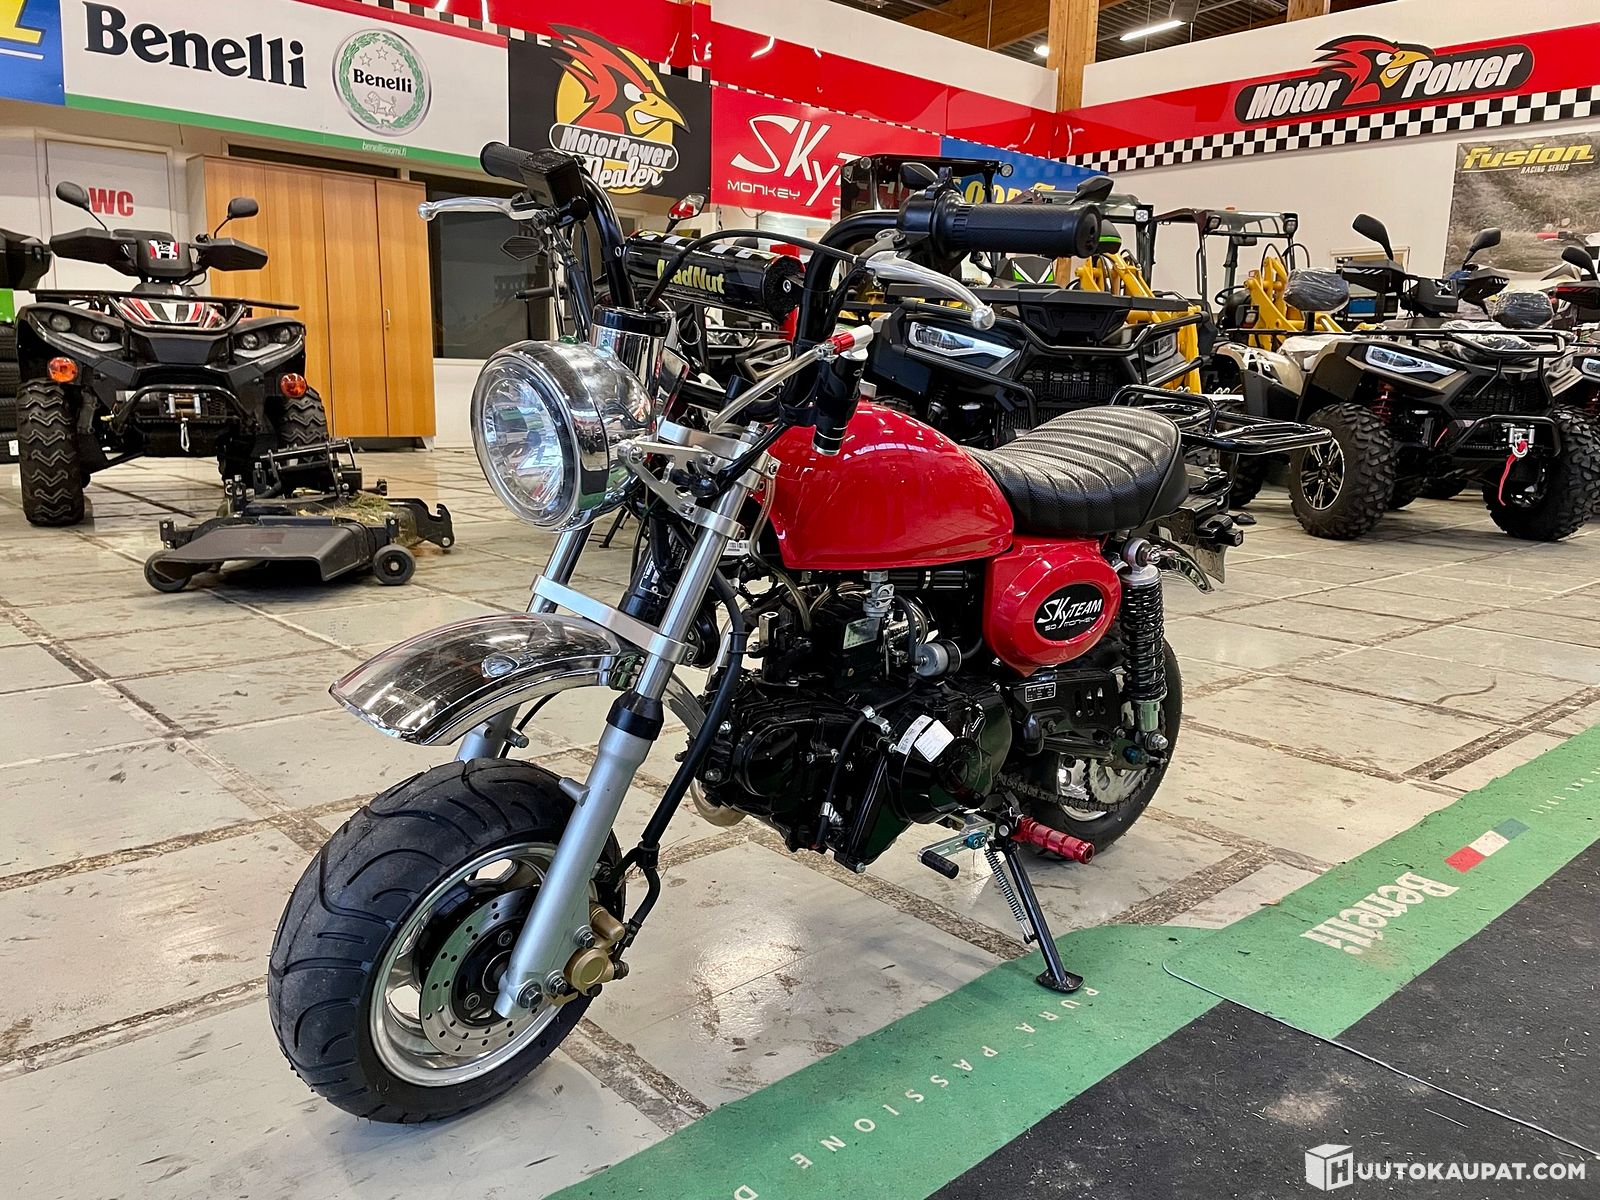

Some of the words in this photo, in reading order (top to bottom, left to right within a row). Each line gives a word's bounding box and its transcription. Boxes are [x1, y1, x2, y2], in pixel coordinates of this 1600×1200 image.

[82, 1, 307, 89] Benelli
[353, 68, 412, 93] Benelli
[1245, 78, 1342, 120] Motor
[1401, 52, 1523, 98] Power
[1520, 165, 1545, 174] RACING
[1547, 164, 1570, 173] SERIES
[89, 187, 134, 217] WC
[1300, 871, 1460, 955] Benelli
[1015, 986, 1100, 1034] PURA
[789, 1045, 999, 1170] PASSIONE
